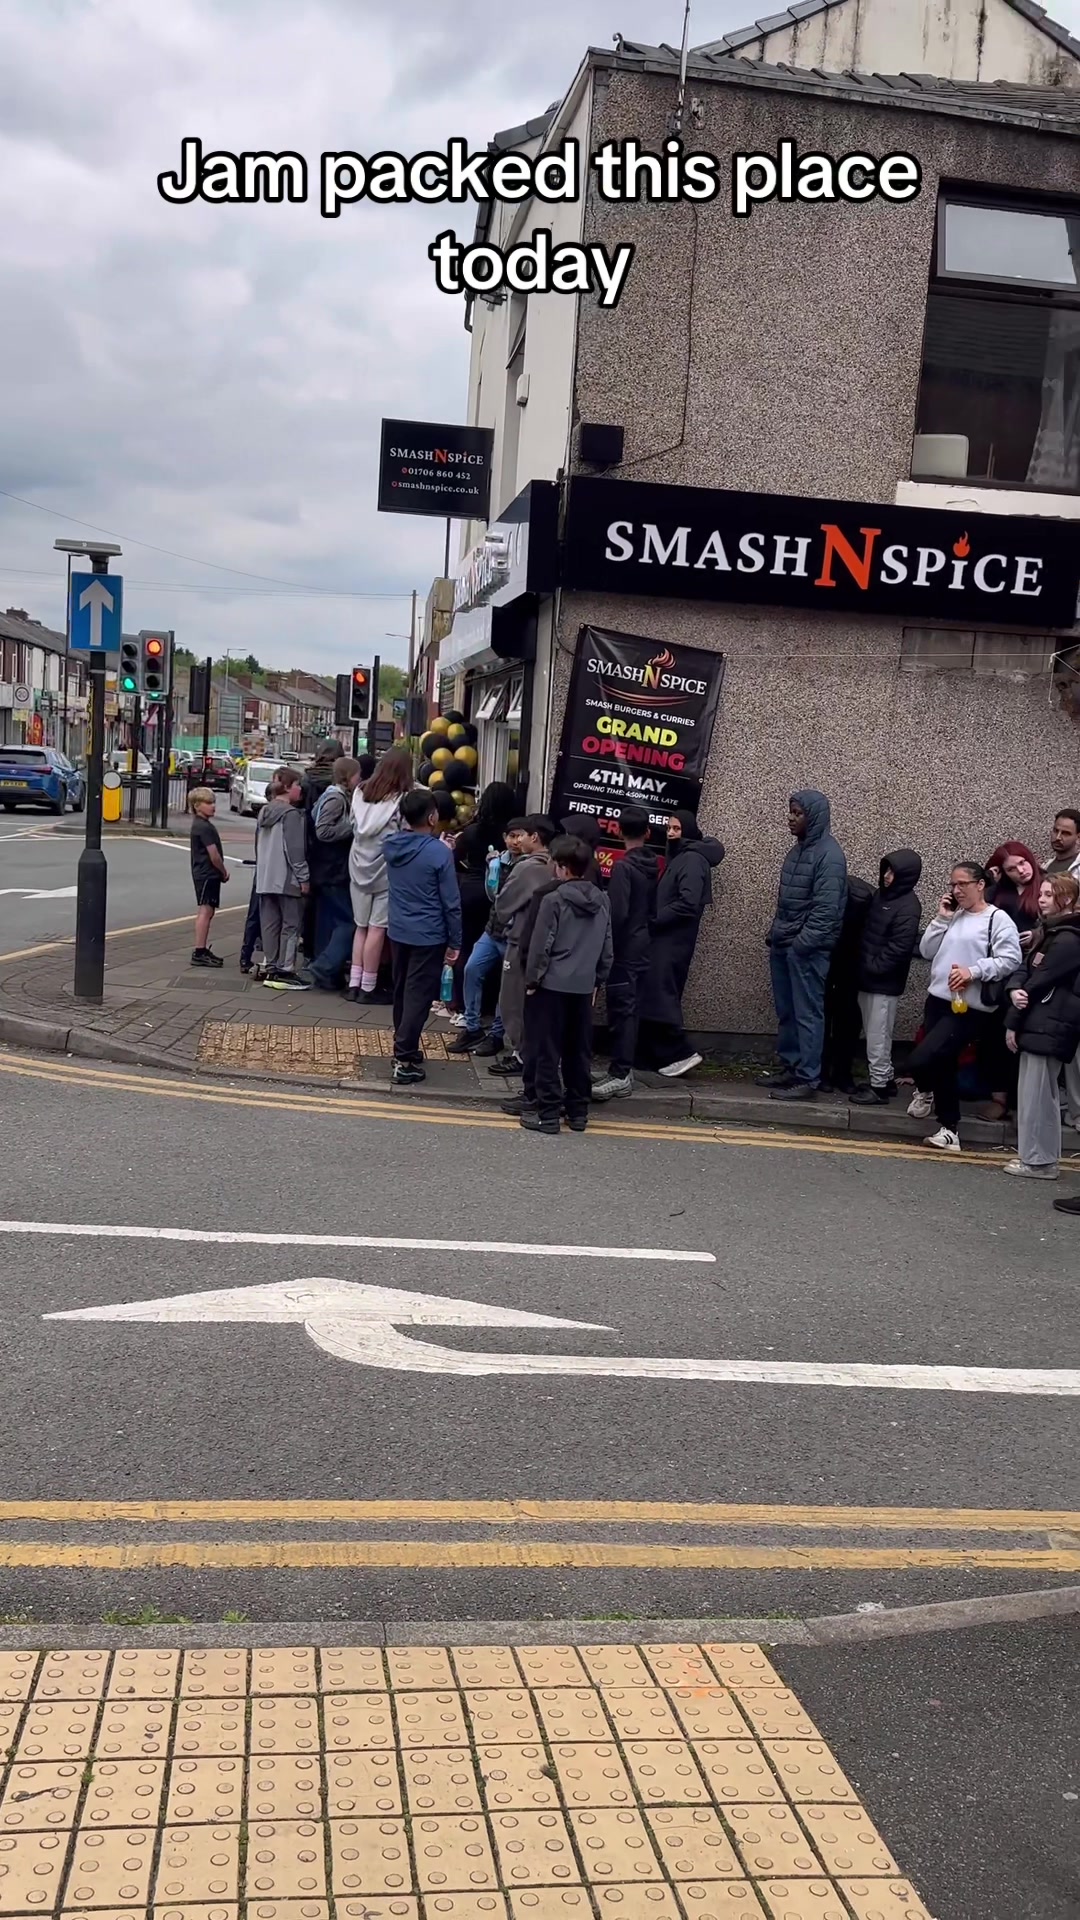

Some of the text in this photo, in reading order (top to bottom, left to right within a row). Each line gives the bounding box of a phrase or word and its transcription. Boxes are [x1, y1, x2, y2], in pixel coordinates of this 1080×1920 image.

[408, 467, 471, 480] 01706 860 452
[398, 481, 480, 495] smashnspice.co.uk
[585, 699, 695, 727] SMASH BURGERS & CURRIES
[596, 716, 678, 747] GRAND
[582, 736, 686, 771] OPENING
[589, 769, 667, 793] 4TH MAY
[573, 782, 605, 793] OPENING
[649, 794, 661, 802] TIL
[661, 797, 679, 806] LATE
[568, 801, 603, 815] FIRST
[605, 808, 621, 818] 50
